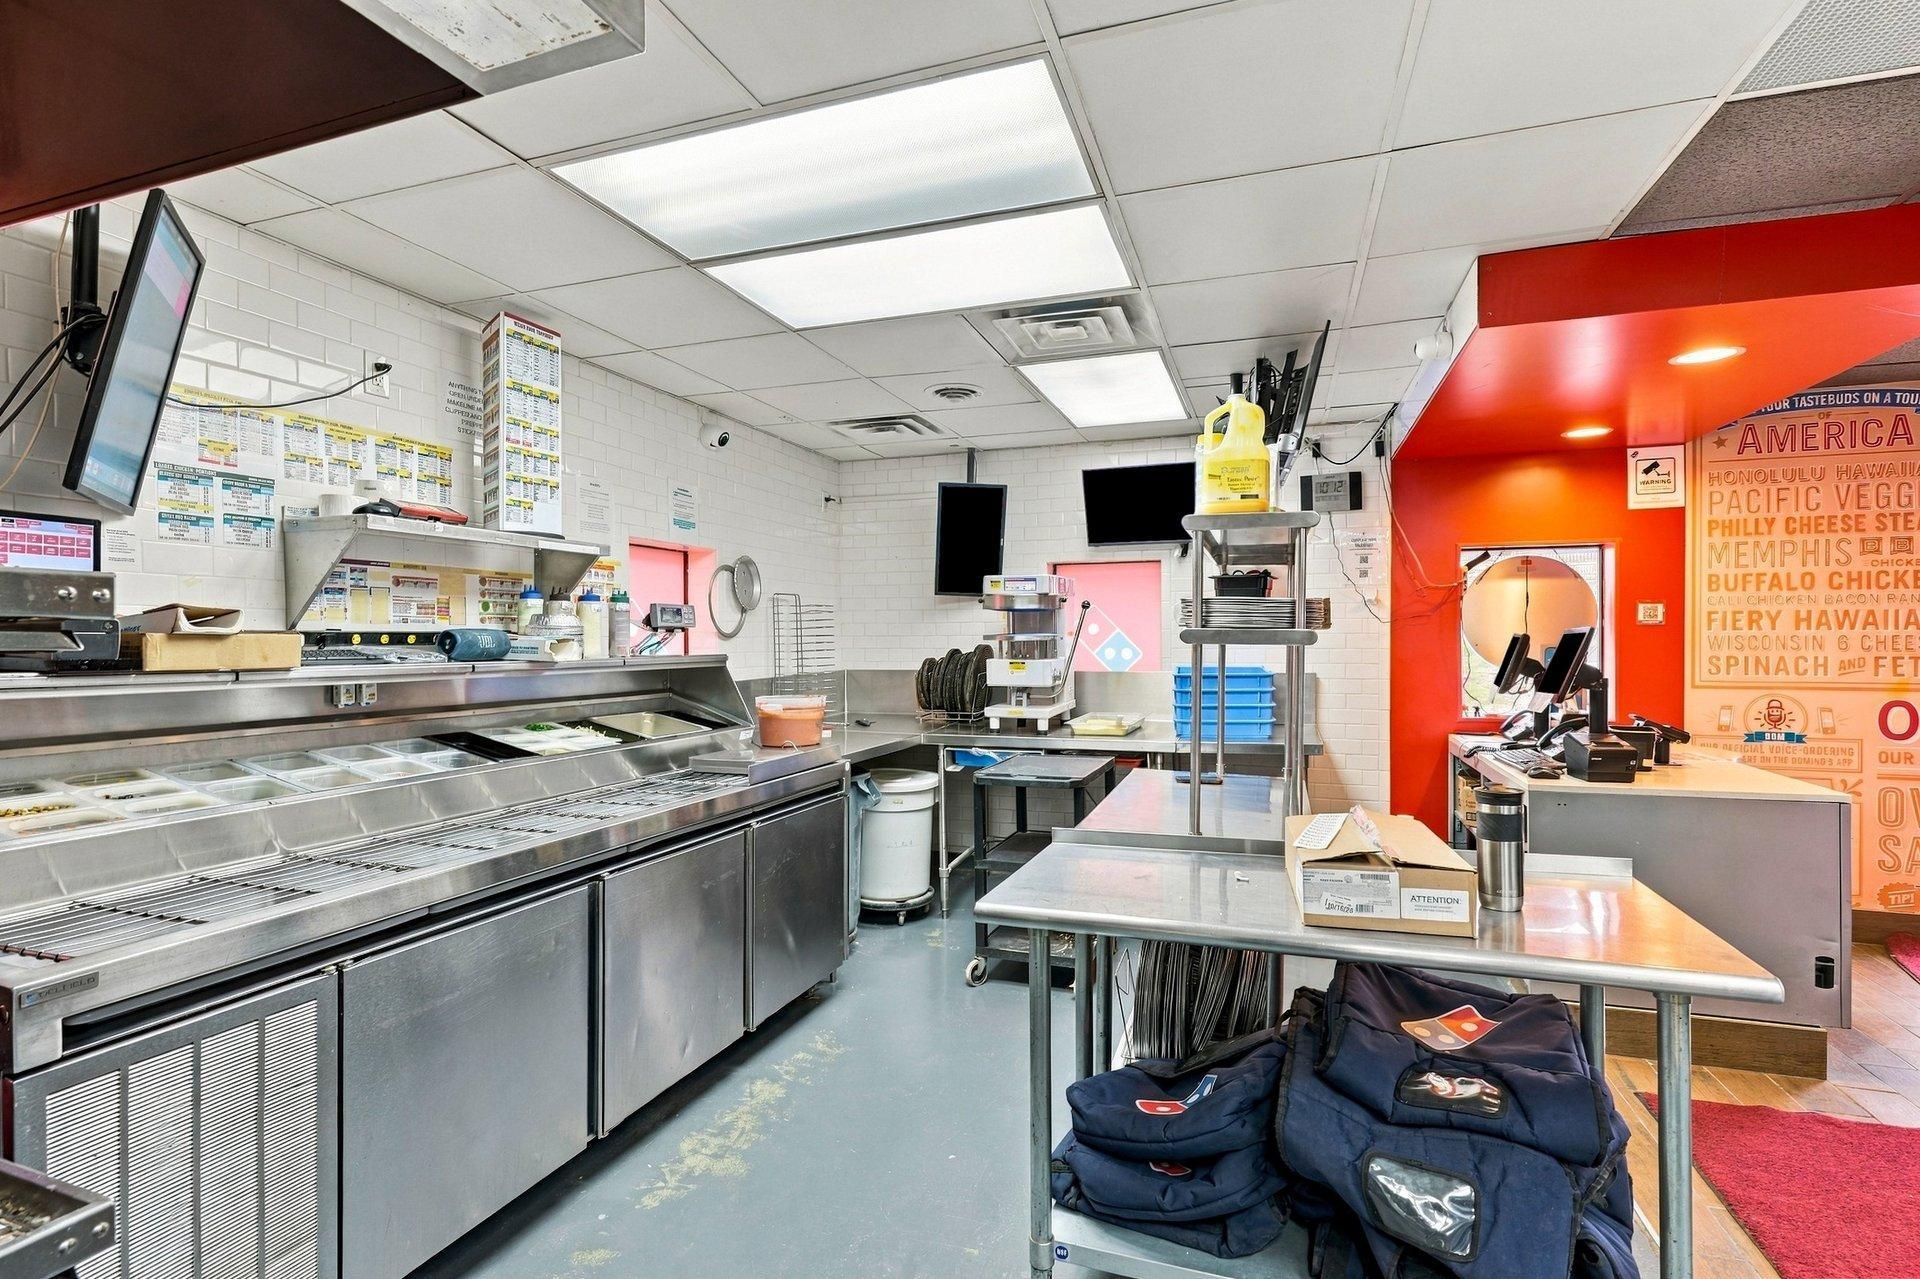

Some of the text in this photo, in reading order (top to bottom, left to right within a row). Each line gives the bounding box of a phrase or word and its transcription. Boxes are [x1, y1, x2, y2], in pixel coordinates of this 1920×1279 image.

[1793, 392, 1860, 408] TASTEBUDS
[1864, 392, 1880, 404] ON
[1883, 392, 1892, 404] A
[1894, 392, 1920, 404] TOU
[1818, 411, 1832, 420] OF
[1738, 414, 1914, 455] AMERICA
[1640, 478, 1672, 486] WARNING
[1708, 466, 1826, 486] HONOLULU
[1708, 486, 1822, 516] PACIFIC
[1708, 517, 1776, 538] PHILLY
[1784, 513, 1866, 536] CHEESE
[1708, 537, 1852, 570] MEMPHIS
[1708, 570, 1815, 592] BUFFALO
[1708, 595, 1742, 606] CALI
[1746, 594, 1816, 606] CHICKEN
[1824, 594, 1880, 604] BACON
[1708, 610, 1780, 631] FIERY
[478, 635, 496, 648] JBL
[1708, 634, 1823, 651] WISCONSIN
[1838, 634, 1848, 651] 6
[1708, 656, 1828, 676] SPINACH
[1838, 657, 1866, 672] AND
[1764, 732, 1785, 740] DOM
[1774, 756, 1789, 764] THE
[1836, 758, 1854, 766] APP
[1878, 750, 1914, 764] OUR
